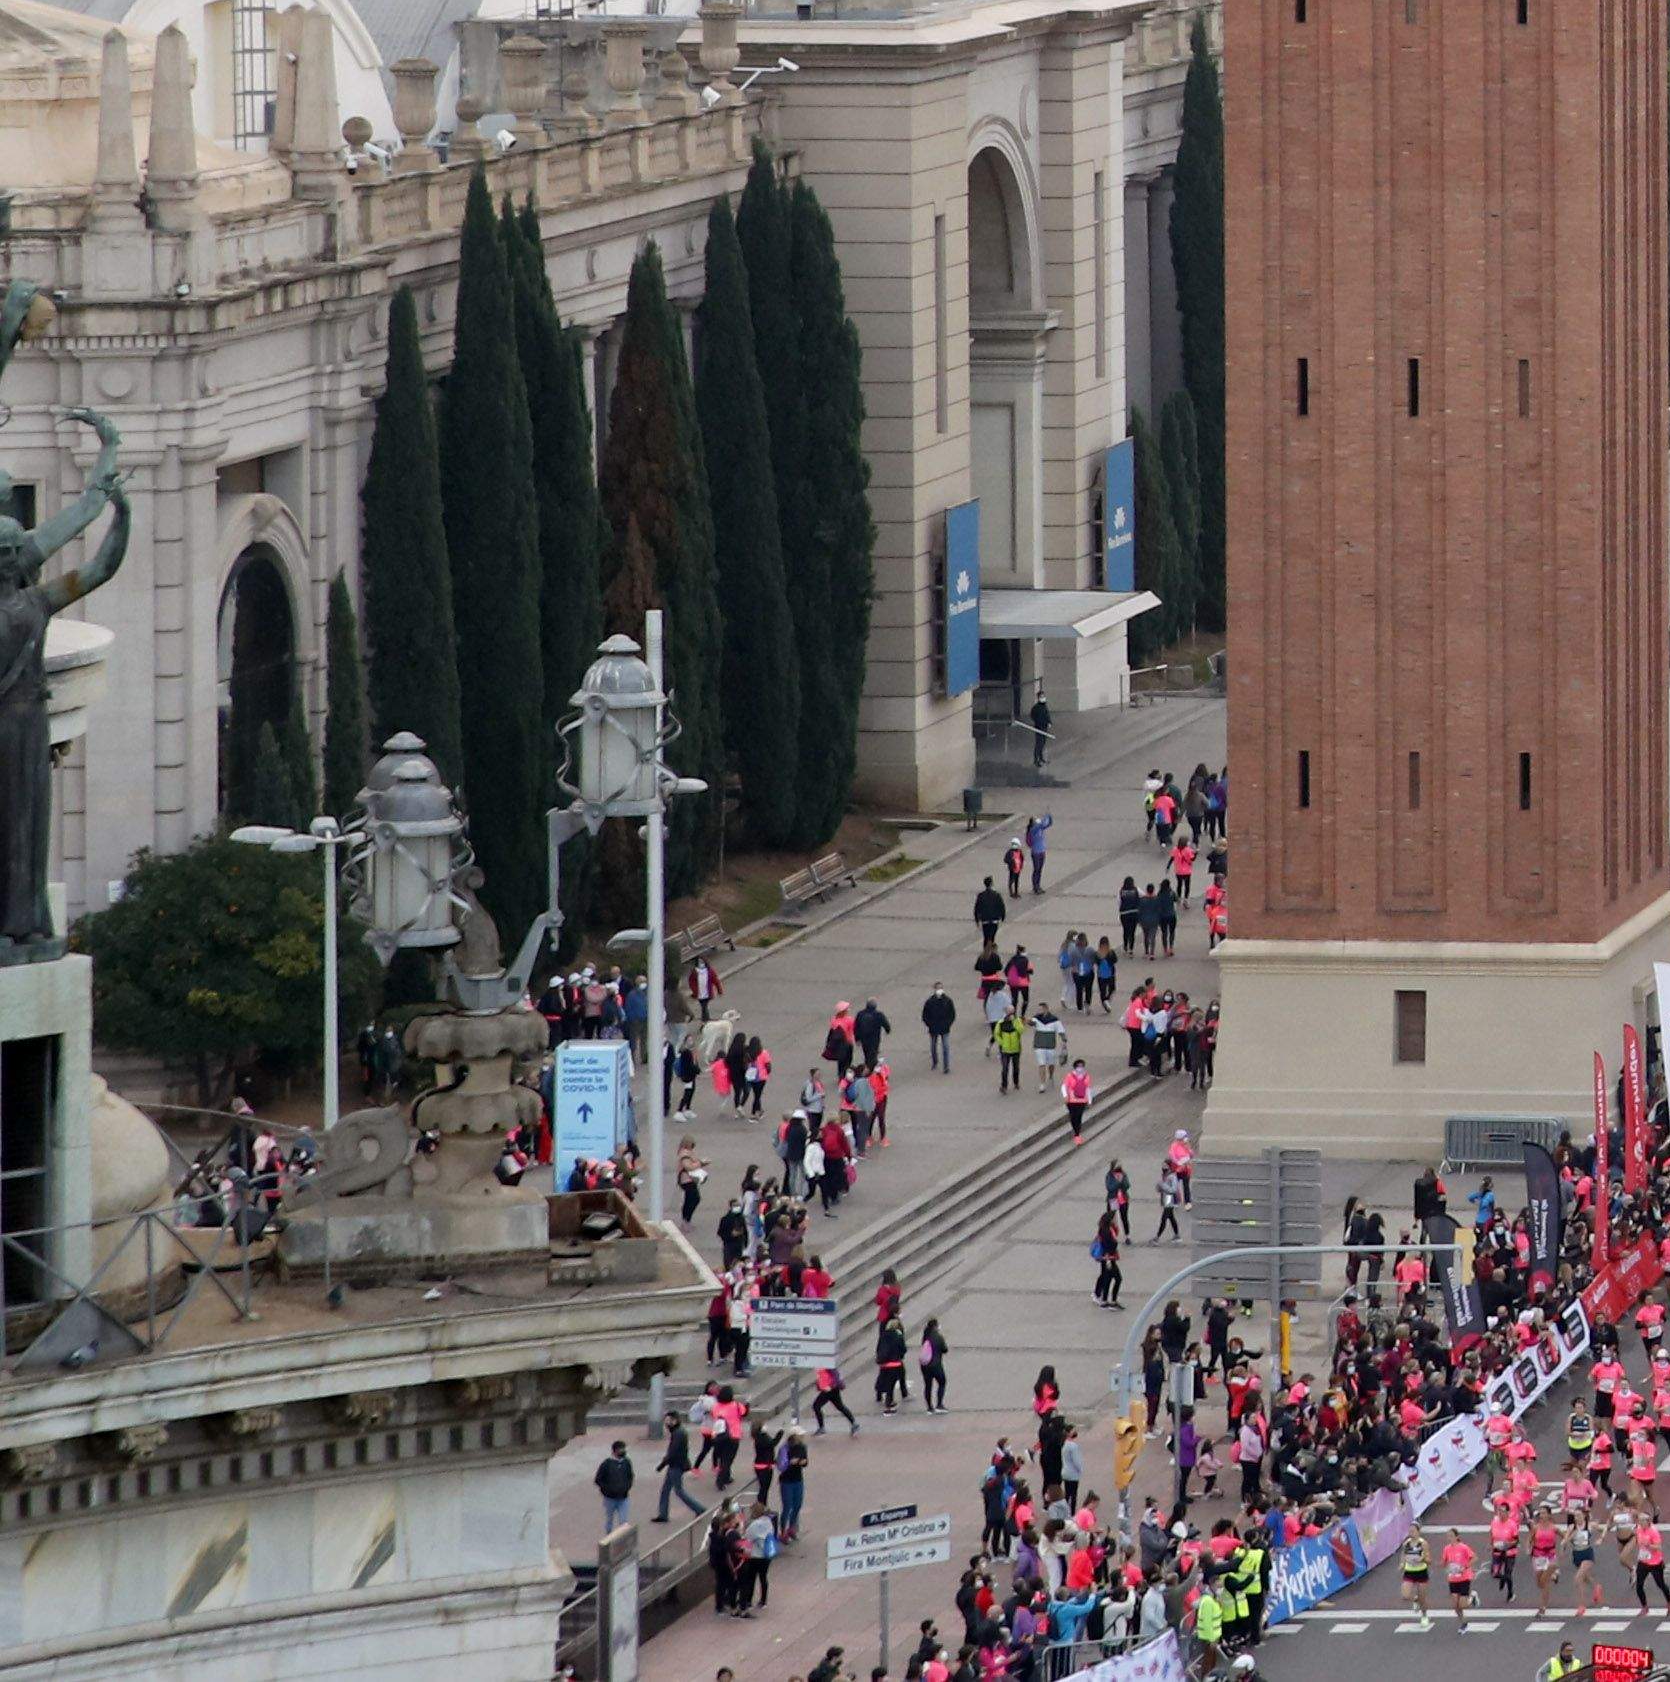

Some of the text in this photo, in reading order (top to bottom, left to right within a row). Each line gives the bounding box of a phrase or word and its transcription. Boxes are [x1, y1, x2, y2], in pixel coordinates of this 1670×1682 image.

[562, 1057, 599, 1065] Punt de
[562, 1075, 603, 1084] contra la
[562, 1084, 608, 1093] COVID-19
[861, 1530, 886, 1546] Reina
[901, 1521, 936, 1537] Cristina
[843, 1558, 864, 1571] Fira
